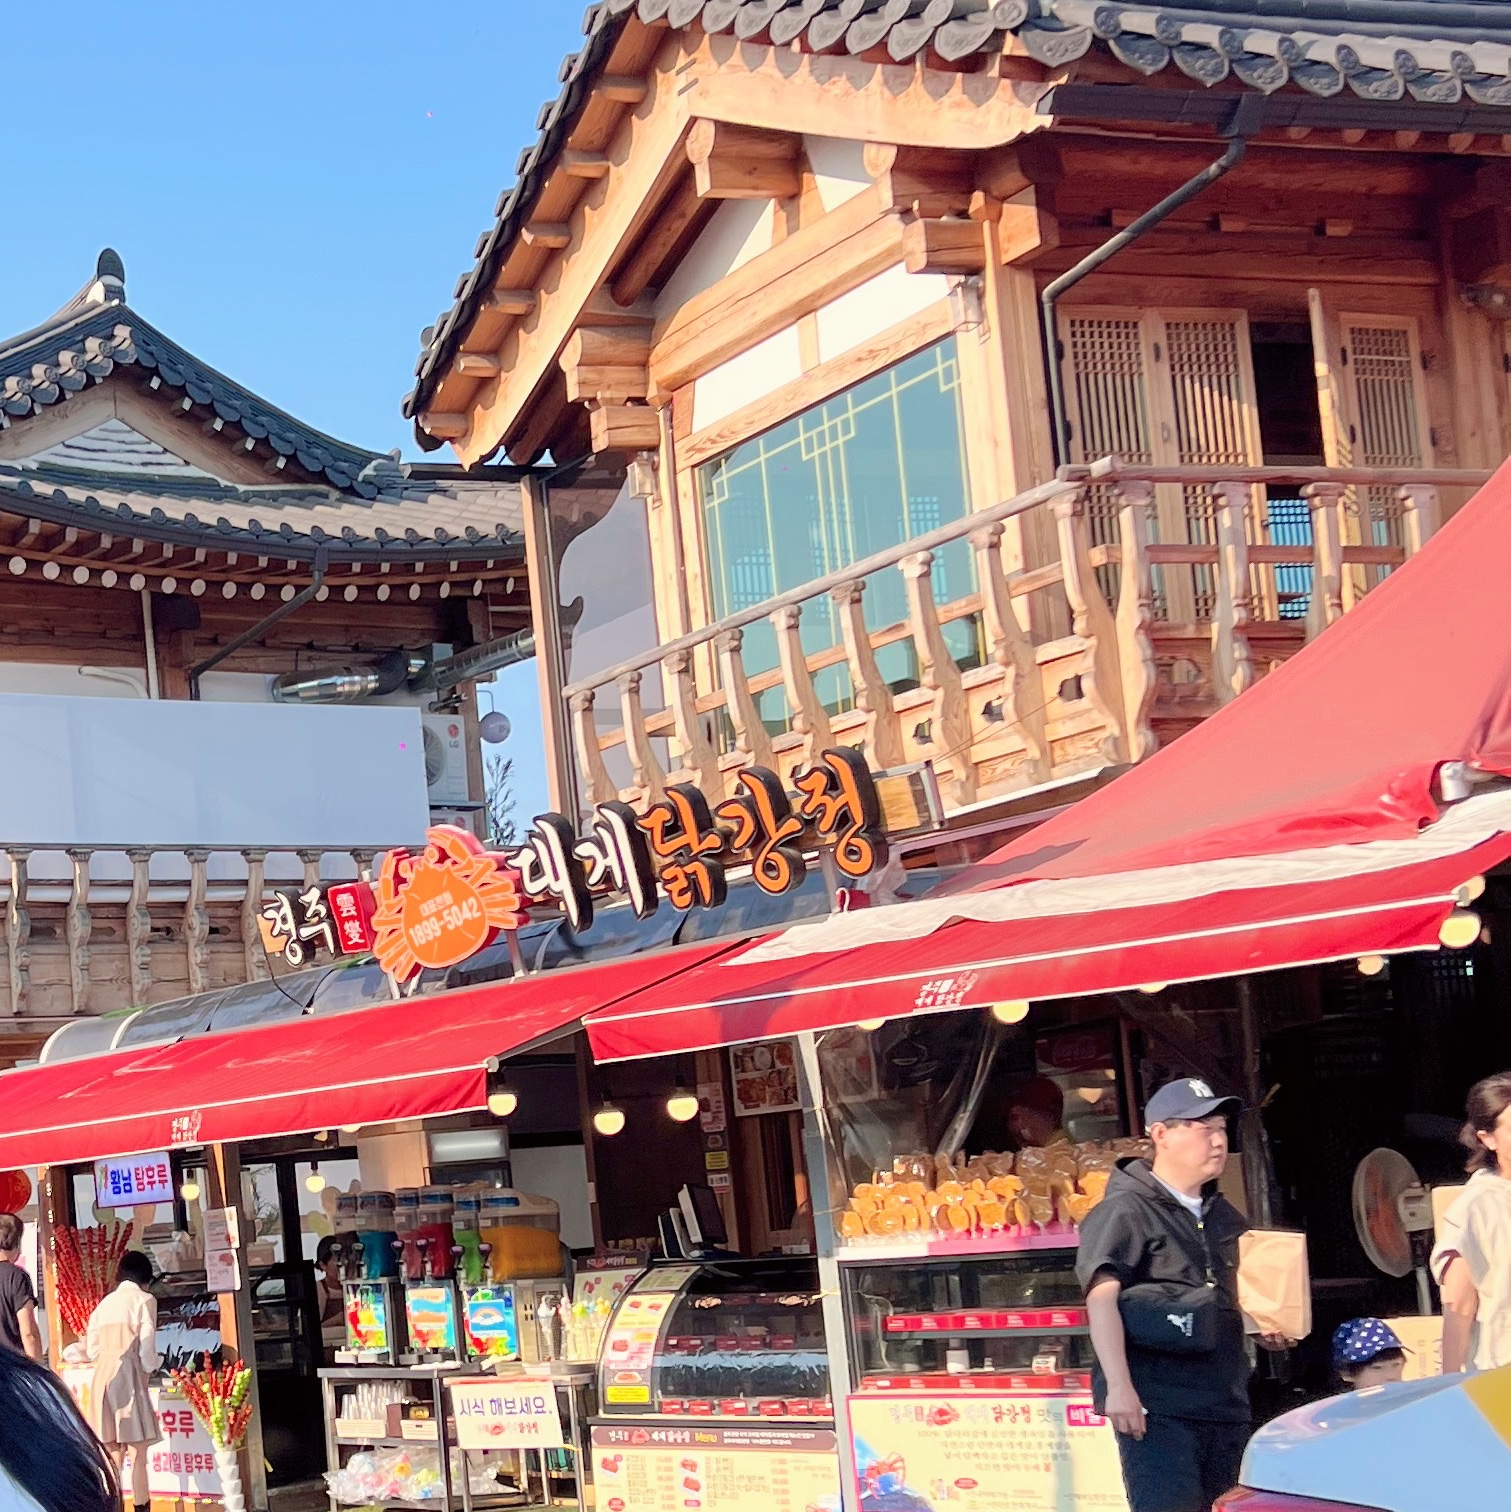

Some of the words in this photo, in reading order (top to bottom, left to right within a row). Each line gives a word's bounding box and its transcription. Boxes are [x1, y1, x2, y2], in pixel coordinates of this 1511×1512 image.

[449, 741, 459, 749] LG
[505, 804, 646, 930] 대게
[638, 751, 874, 912] 닭강정
[262, 886, 336, 968] 경주
[409, 896, 482, 948] 1899-5042
[110, 1168, 133, 1195] 황남
[134, 1164, 168, 1192] 탕후루
[460, 1398, 485, 1416] 시식
[155, 1409, 194, 1439] 후루
[184, 1453, 214, 1474] 탕후루
